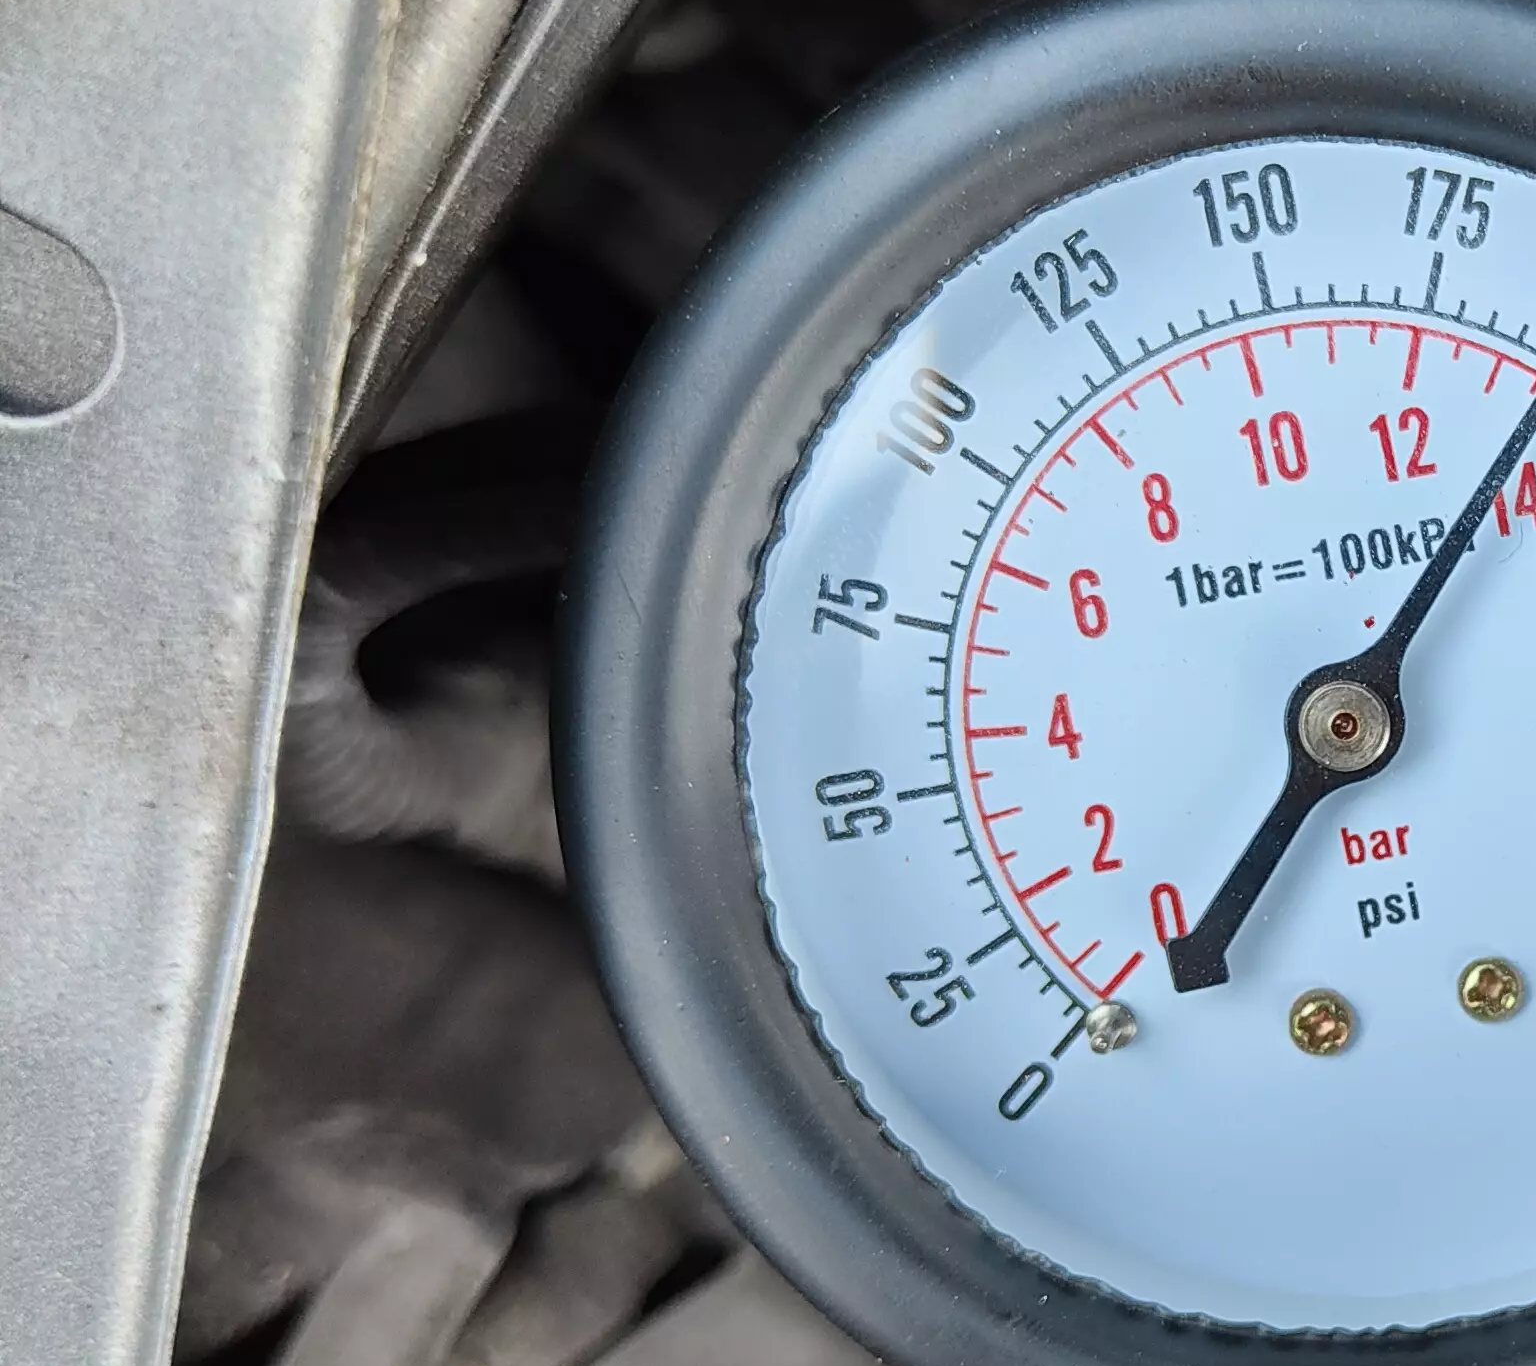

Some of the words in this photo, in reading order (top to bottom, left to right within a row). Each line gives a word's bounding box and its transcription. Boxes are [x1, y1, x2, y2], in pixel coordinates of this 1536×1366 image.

[1192, 164, 1300, 247] 150
[1404, 167, 1495, 250] 175
[1010, 229, 1121, 334] 125
[876, 366, 975, 477] 100
[1238, 410, 1309, 487] 10
[1369, 405, 1438, 483] 12
[1142, 472, 1181, 544] 8
[1165, 517, 1475, 608] 1bar=100kP
[811, 573, 890, 642] 75
[1069, 569, 1109, 638] 6
[1046, 693, 1083, 759] 4
[815, 767, 893, 842] 50
[1084, 803, 1123, 873] 2
[1340, 824, 1411, 868] bar
[1148, 882, 1187, 947] 0
[1357, 882, 1421, 938] psi
[884, 946, 976, 1028] 25
[998, 1060, 1053, 1122] 0
